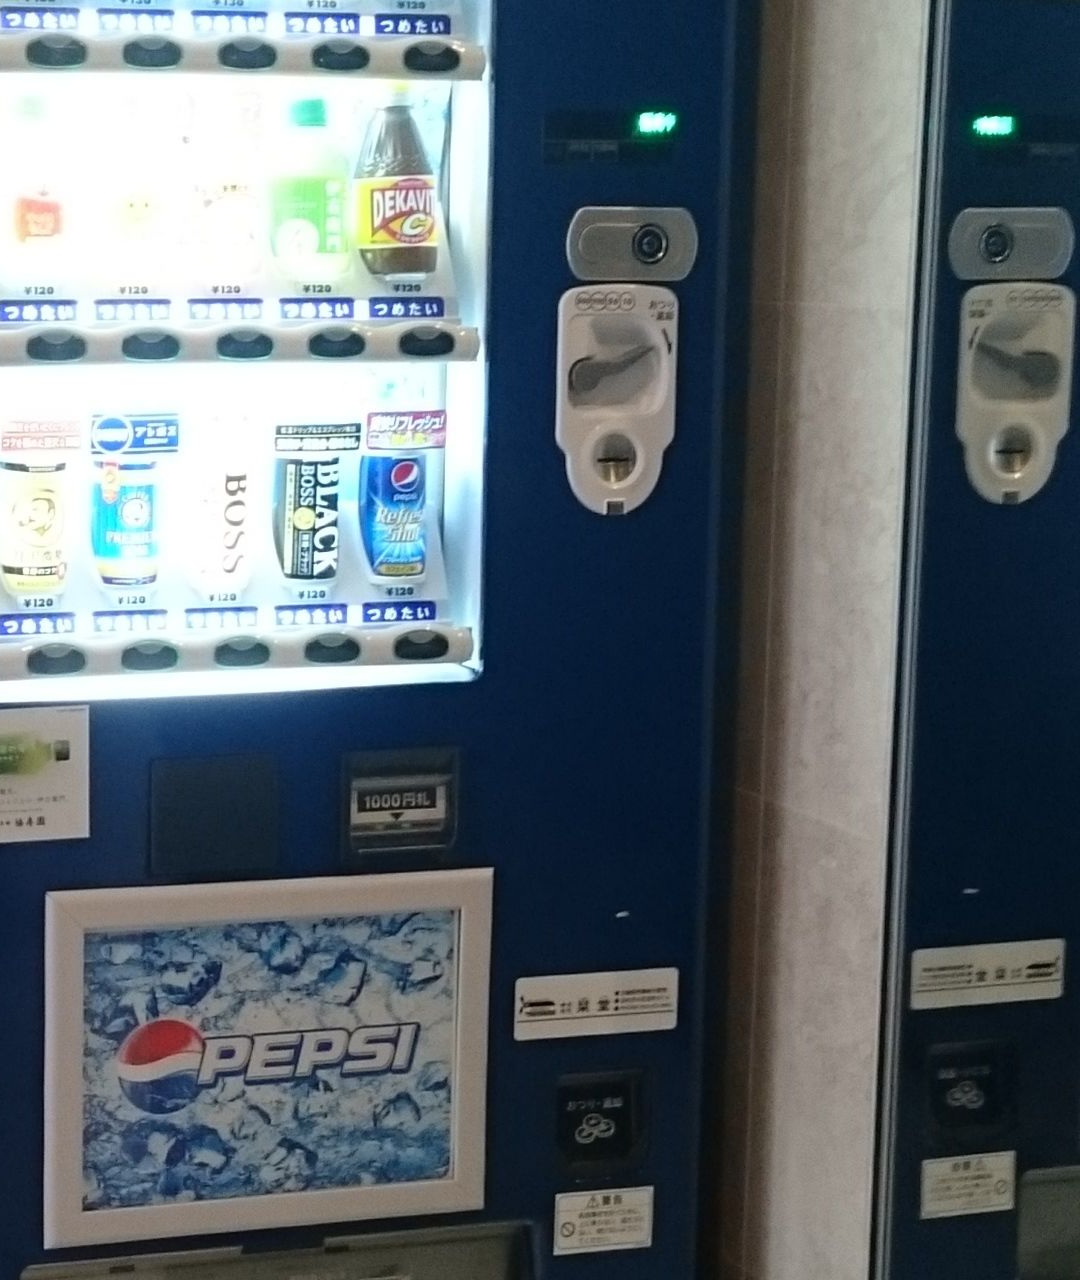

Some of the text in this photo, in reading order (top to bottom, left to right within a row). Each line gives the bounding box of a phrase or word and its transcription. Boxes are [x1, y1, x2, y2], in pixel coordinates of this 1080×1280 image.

[380, 20, 444, 33] つめたい
[401, 213, 427, 236] C
[374, 302, 438, 315] つめたい
[300, 463, 315, 506] BOSS
[223, 473, 247, 574] BOSS
[313, 463, 339, 577] BLACK
[366, 607, 430, 621] つめたい
[364, 791, 431, 810] 1000円札
[197, 1022, 421, 1088] PEPSI
